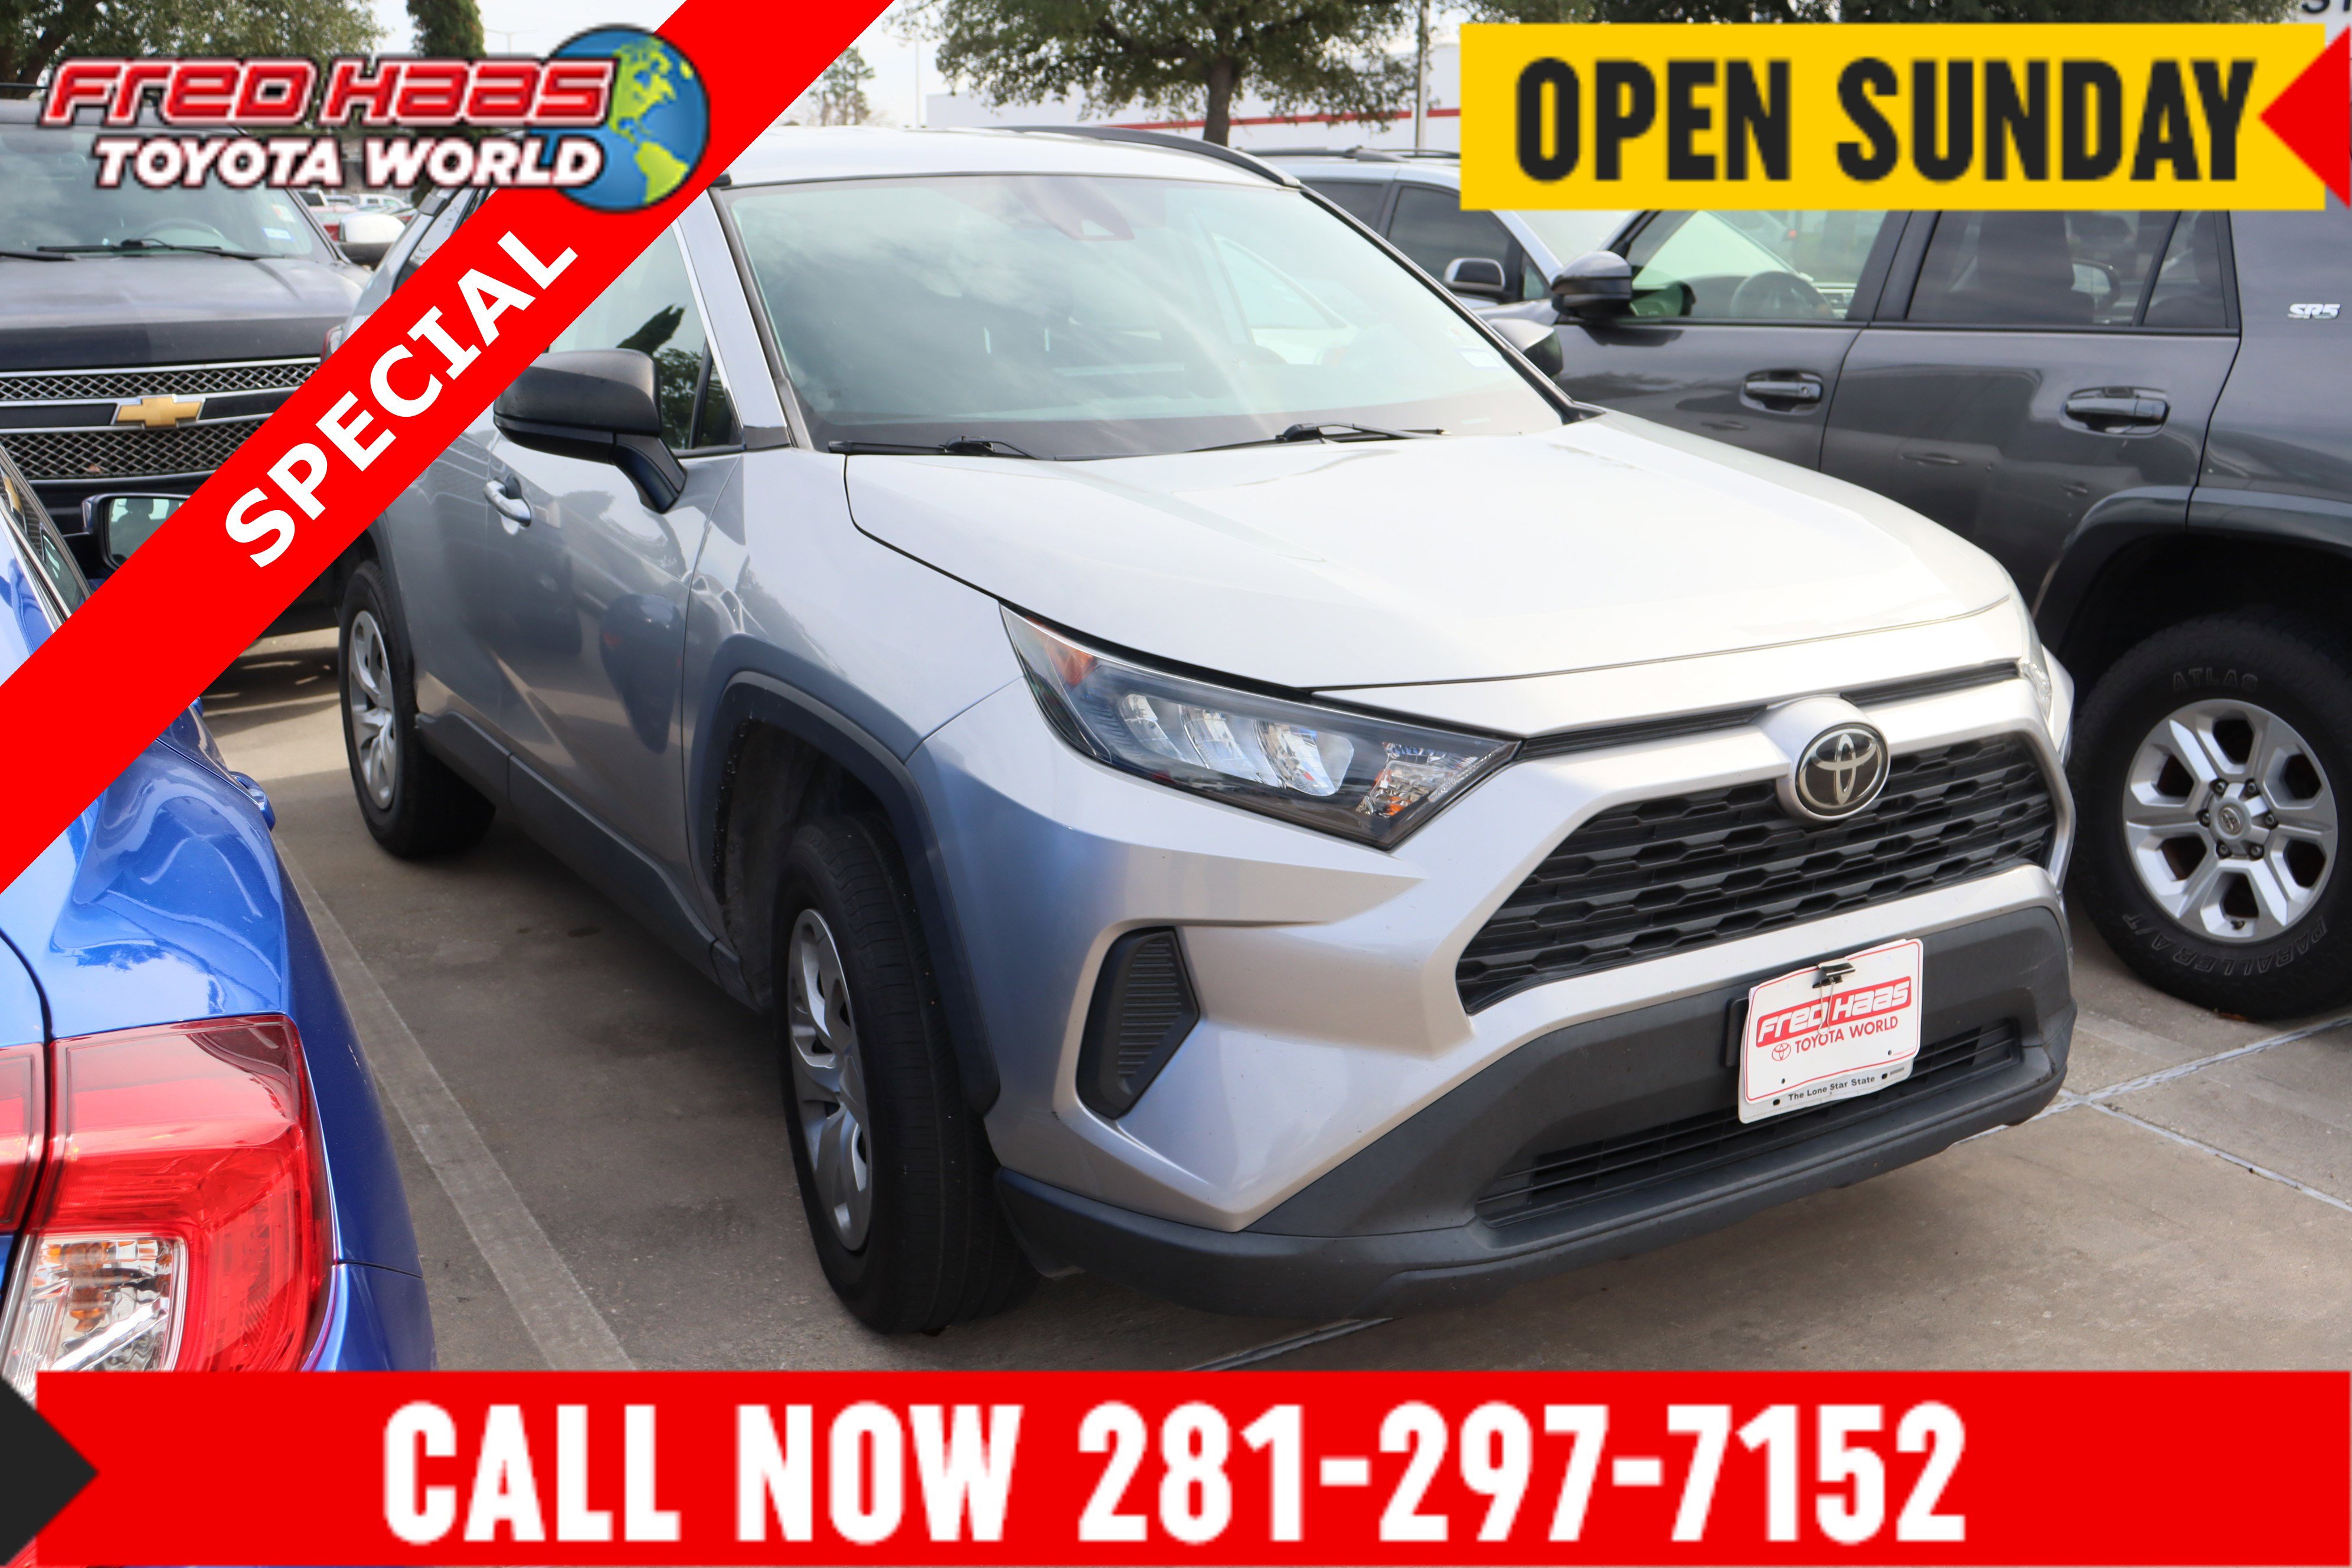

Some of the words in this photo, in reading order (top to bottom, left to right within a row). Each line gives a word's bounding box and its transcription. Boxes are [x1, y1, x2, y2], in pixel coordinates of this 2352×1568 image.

[2288, 303, 2341, 319] SR5
[2173, 667, 2258, 692] ATLAS
[2173, 916, 2328, 976] PARALLER
[1795, 1028, 1844, 1053] TOYOTA
[1849, 1015, 1898, 1038] WORLD
[1788, 1091, 1804, 1101] The
[1807, 1086, 1827, 1097] Lone
[1830, 1081, 1848, 1090] Star
[1851, 1076, 1875, 1086] State
